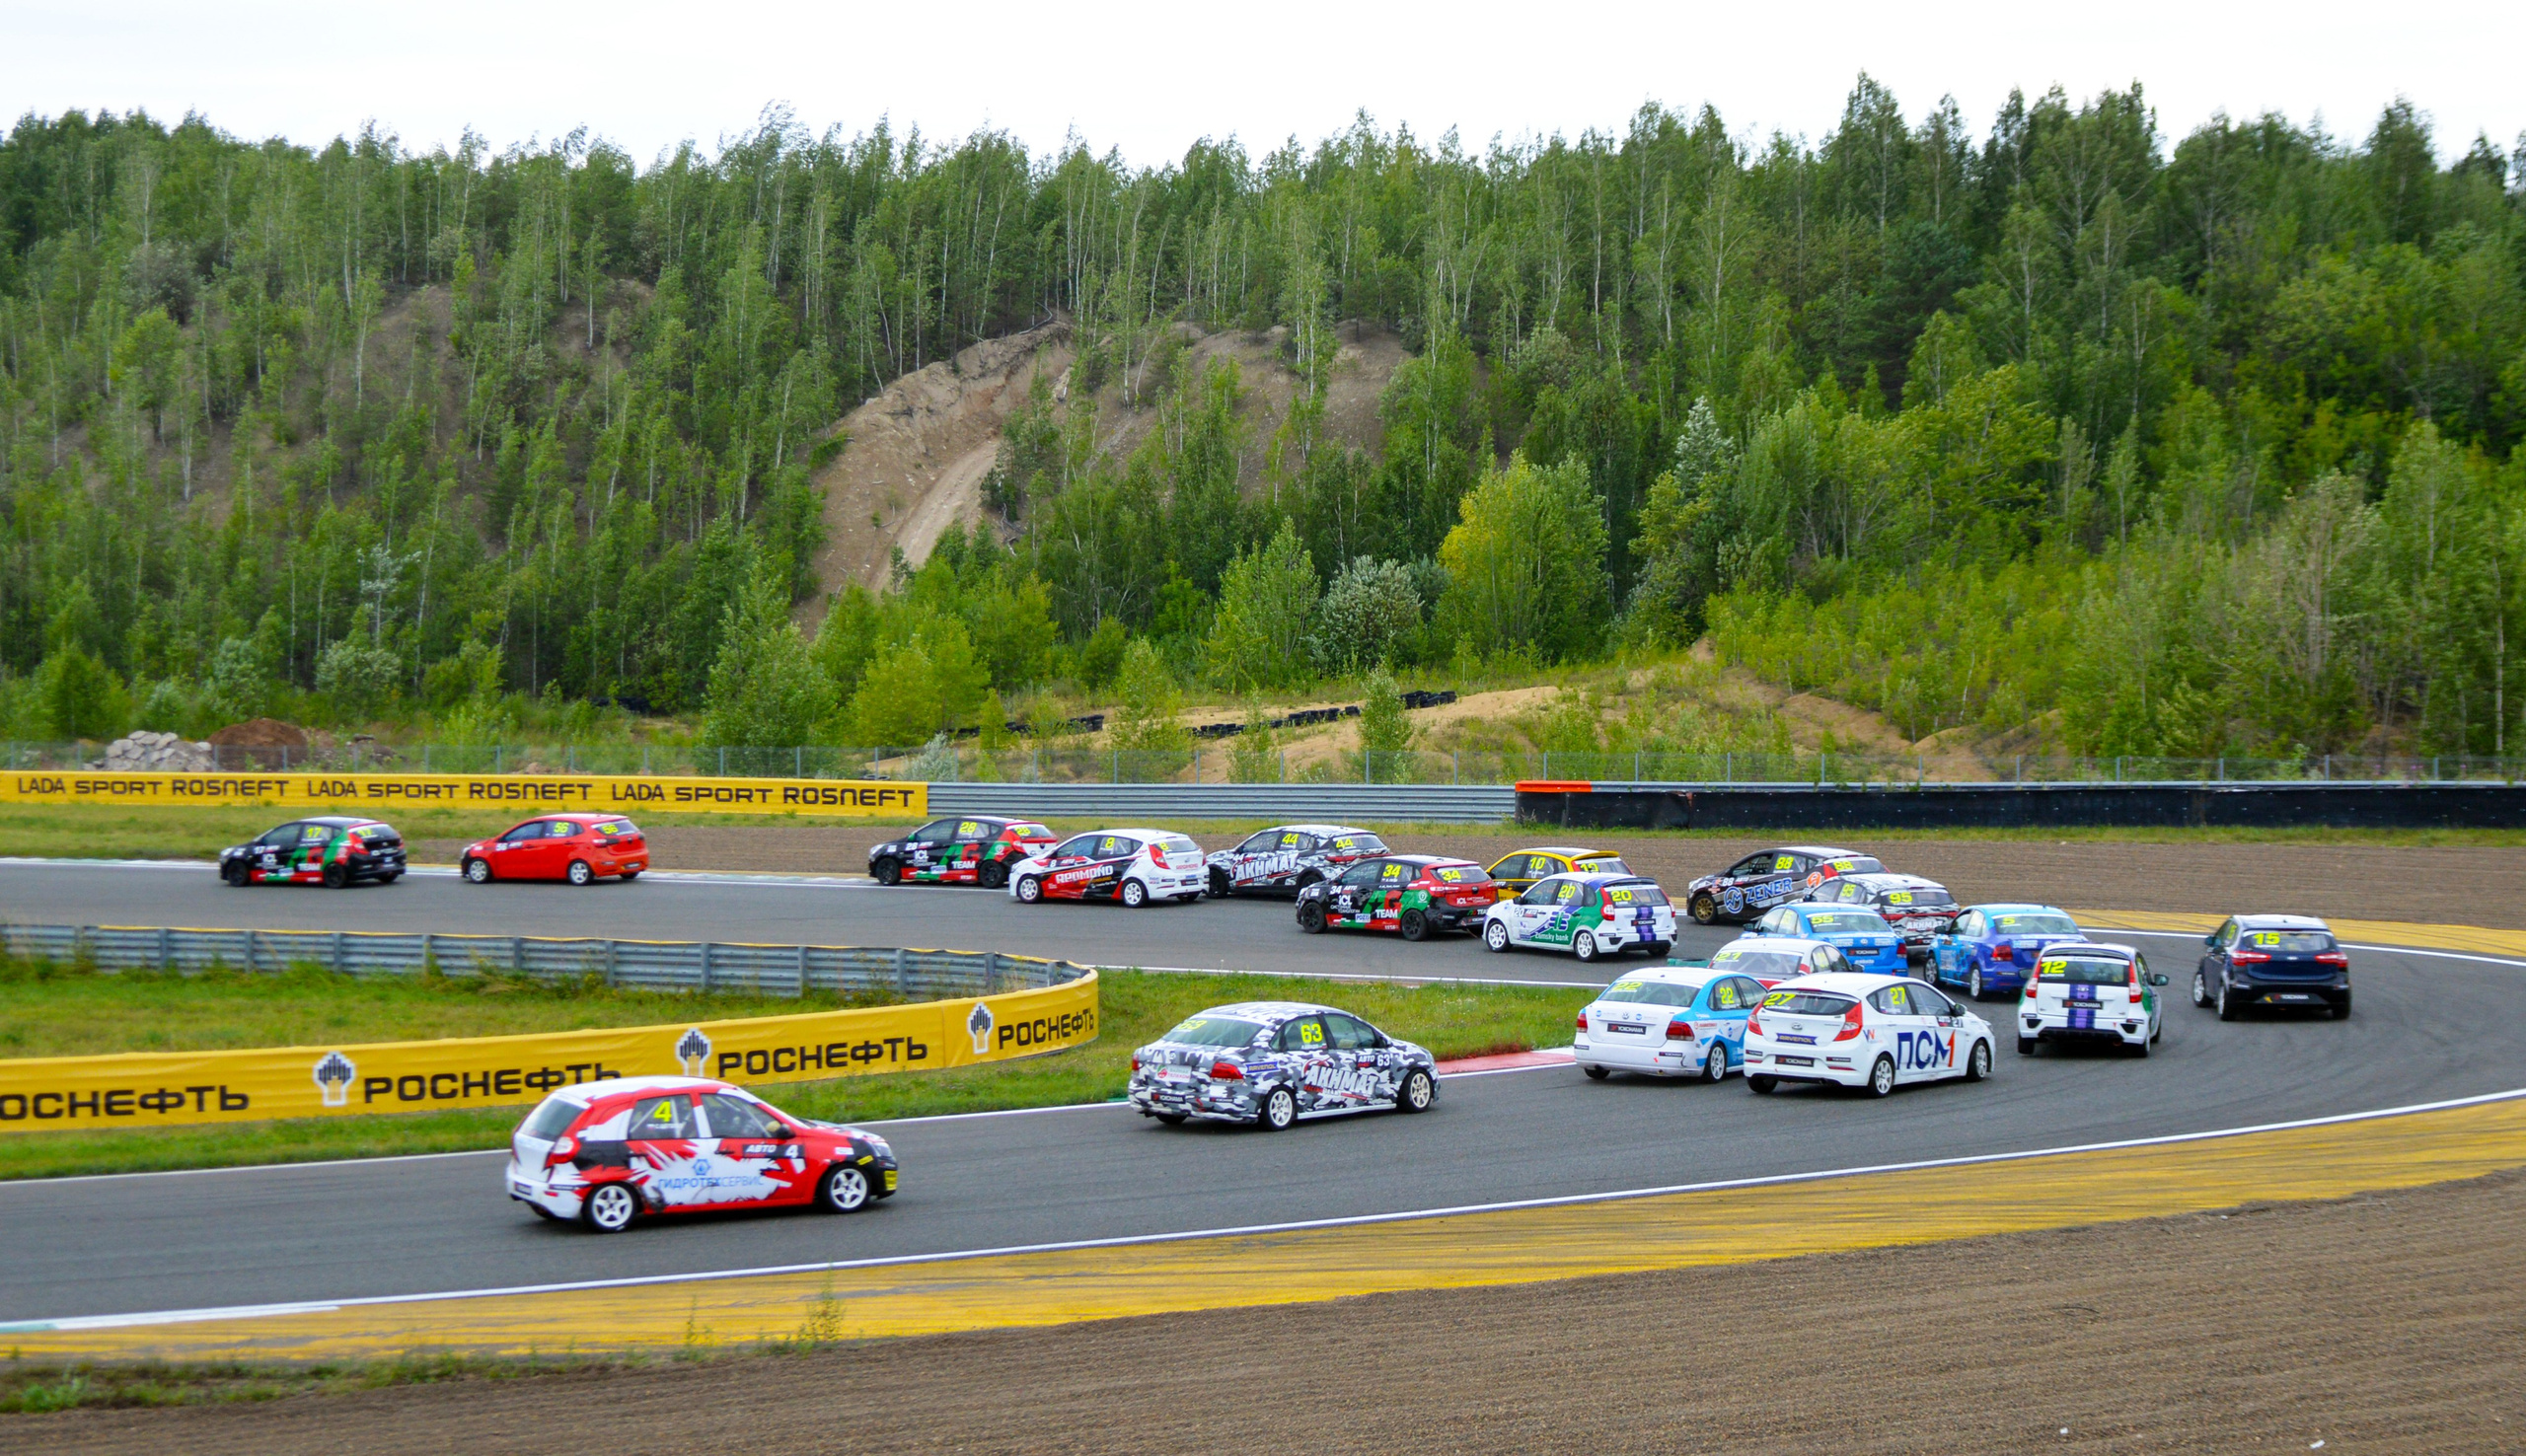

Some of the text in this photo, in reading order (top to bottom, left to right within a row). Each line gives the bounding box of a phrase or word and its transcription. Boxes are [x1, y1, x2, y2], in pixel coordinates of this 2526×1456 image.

[19, 778, 289, 796] LADA SPORT ROSNEFT
[308, 780, 593, 800] LADA SPORT ROSNEFT
[612, 783, 915, 807] LADA SPORT ROSNEFT
[306, 827, 323, 837] 17
[554, 822, 569, 833] 56
[602, 824, 619, 834] 56
[958, 822, 978, 833] 28
[1014, 827, 1031, 837] 28
[1105, 837, 1116, 849] 8
[1282, 833, 1300, 844] 44
[1336, 838, 1354, 848] 44
[1235, 852, 1300, 881] AKHMAT
[1529, 856, 1546, 870] 10
[1776, 856, 1794, 869] 88
[1833, 861, 1854, 871] 88
[1055, 865, 1114, 884] REDMOND
[1382, 864, 1402, 878] 34
[1442, 870, 1461, 881] 34
[1722, 877, 1735, 886] 88
[1329, 885, 1342, 895] 34
[1558, 884, 1576, 899] 20
[1610, 890, 1633, 902] 20
[1745, 877, 1793, 904] ZENER
[1841, 883, 1856, 898] 95
[1889, 892, 1913, 904] 95
[1375, 909, 1398, 918] TEAM
[1515, 908, 1524, 917] 20
[1811, 915, 1834, 924] 55
[1906, 920, 1944, 930] AKHMAT
[2002, 916, 2016, 925] 5
[2253, 932, 2280, 945] 15
[1715, 952, 1743, 962] 21
[2041, 961, 2068, 974] 12
[1612, 982, 1643, 991] 22
[1720, 987, 1735, 1004] 22
[1763, 992, 1796, 1006] 27
[1890, 986, 1905, 1005] 27
[999, 1008, 1094, 1050] РОСНЕФТЬ
[1300, 1023, 1323, 1044] 63
[718, 1036, 929, 1077] РОСНЕФТЬ
[1377, 1055, 1390, 1066] 63
[363, 1062, 622, 1104] РОСНЕФТЬ
[1304, 1064, 1379, 1097] AKHMAT
[653, 1101, 672, 1123] 4
[745, 1144, 799, 1158] АВТО 4
[658, 1175, 765, 1190] ГИДРОТЕХСЕРВИС
